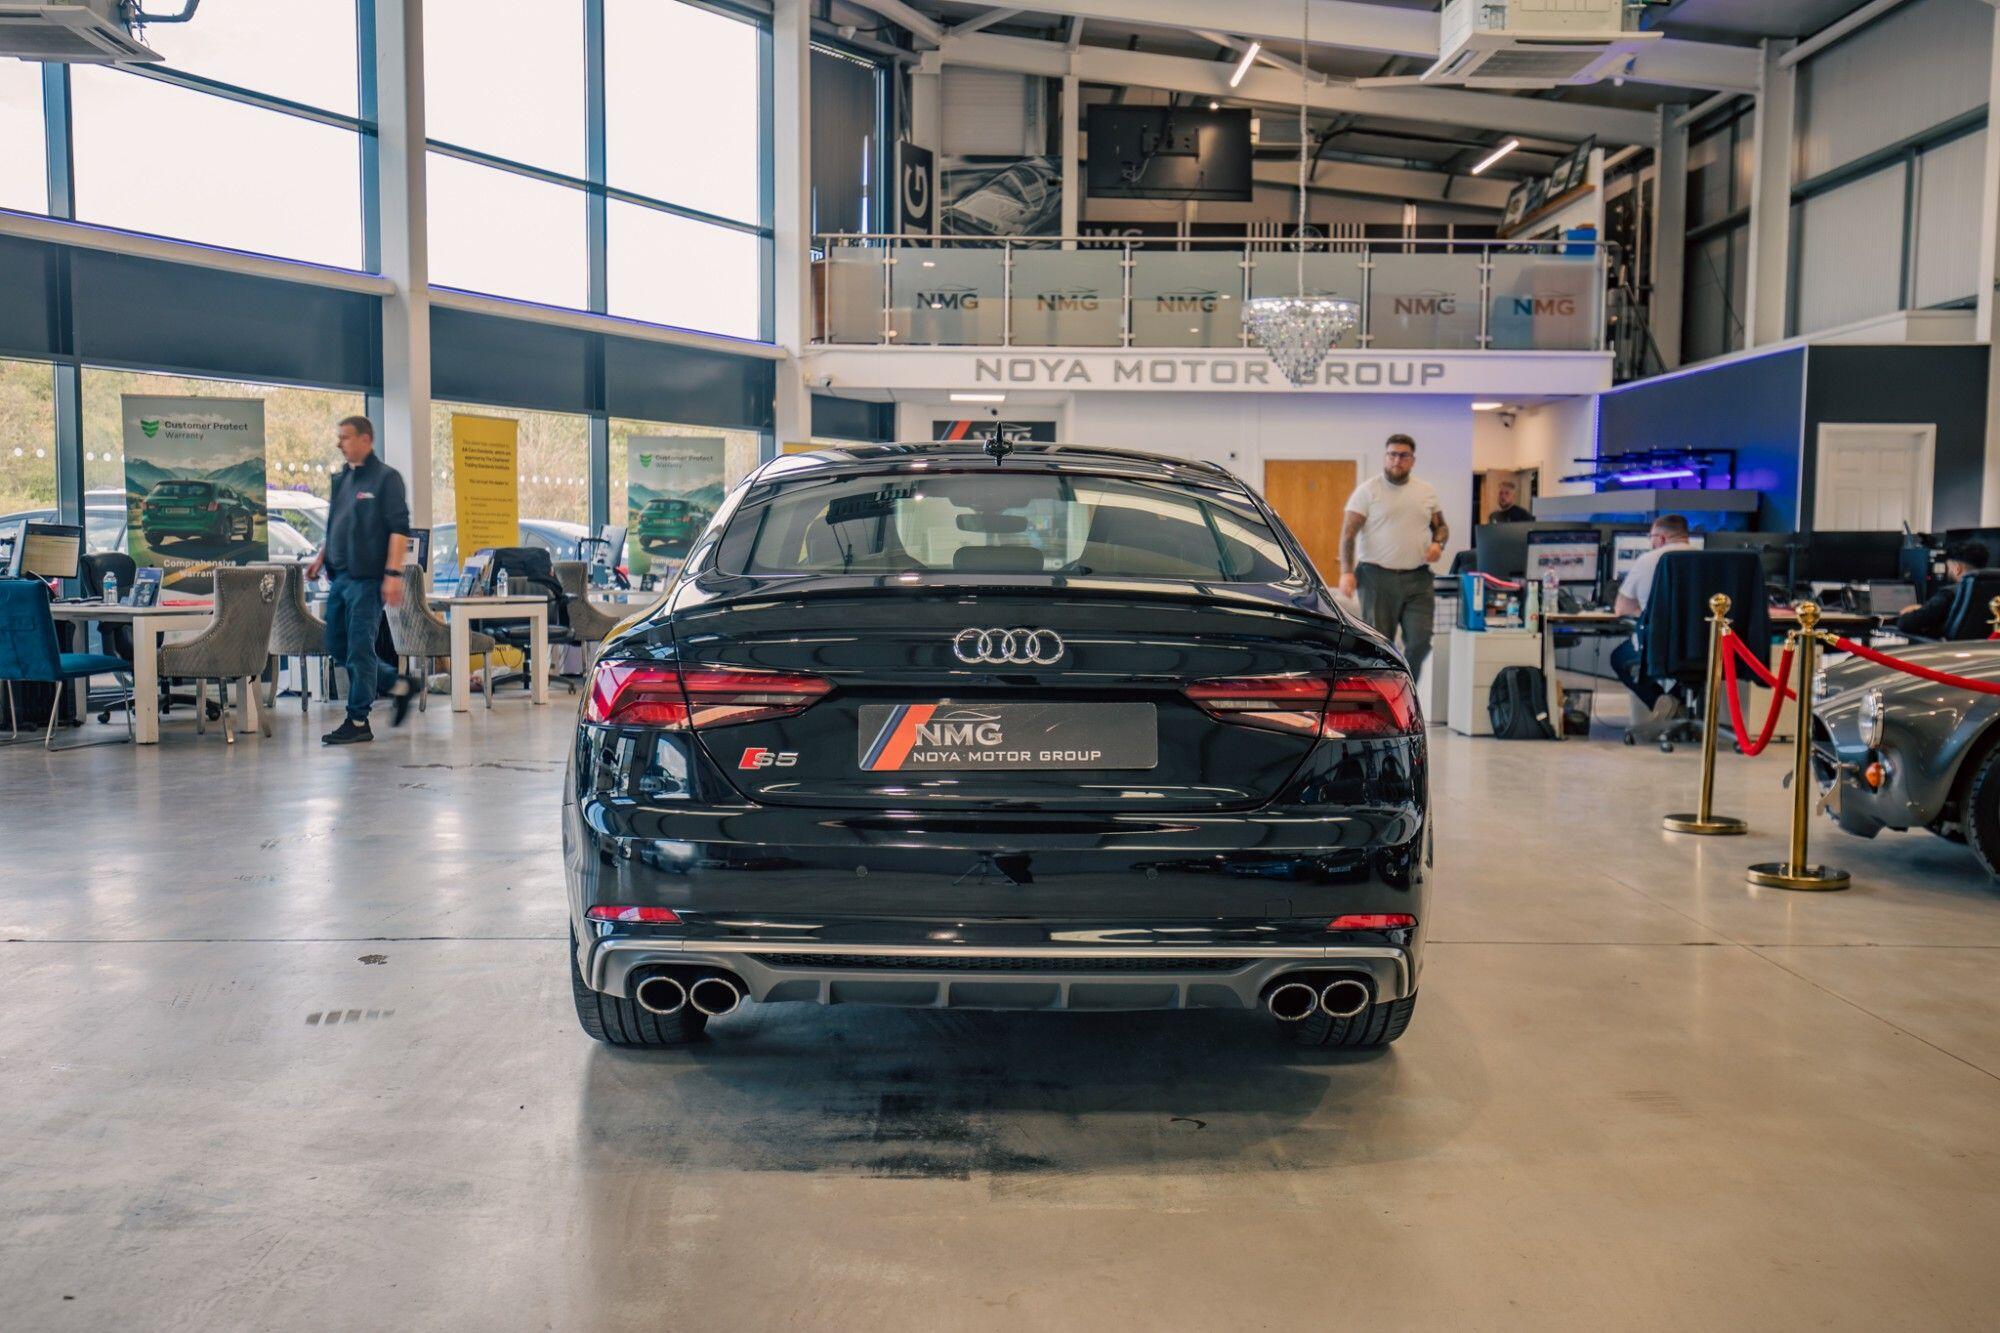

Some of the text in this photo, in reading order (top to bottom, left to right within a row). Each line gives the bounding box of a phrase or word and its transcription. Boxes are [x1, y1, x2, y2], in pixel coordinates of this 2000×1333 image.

[916, 291, 978, 309] NMG
[1037, 293, 1098, 311] NMG
[1156, 294, 1218, 313] NMG
[1394, 297, 1456, 315] NMG
[1513, 297, 1576, 316] NMG
[975, 357, 1092, 383] NOYA
[1114, 359, 1270, 385] MOTOR
[164, 420, 248, 431] Customer Protect
[165, 431, 204, 440] Warranty
[163, 559, 236, 569] Comprehensive
[914, 723, 1003, 746] NMG
[752, 752, 799, 766] S5
[913, 751, 1101, 762] NOYA MOTOR GROUP
